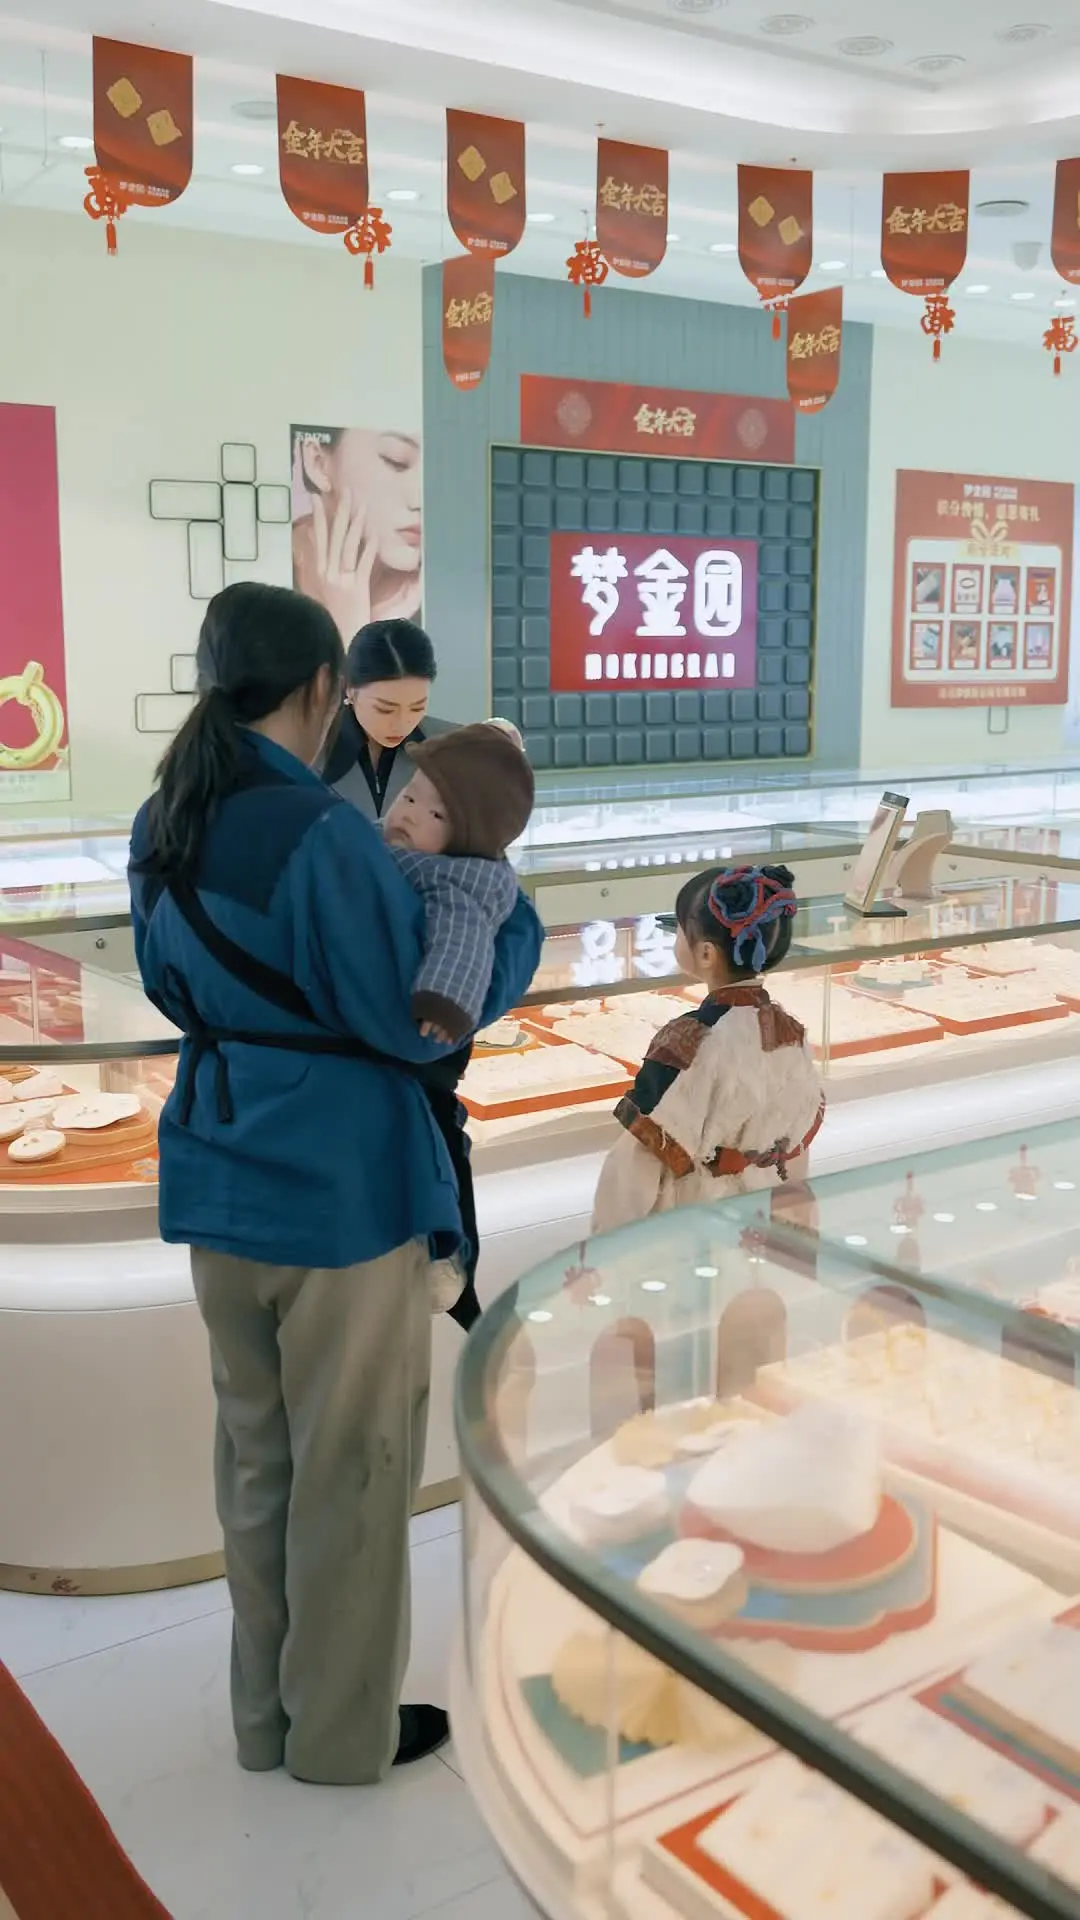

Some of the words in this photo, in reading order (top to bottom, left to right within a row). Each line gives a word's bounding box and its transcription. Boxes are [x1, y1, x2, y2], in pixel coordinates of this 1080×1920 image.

[282, 120, 364, 165] 金年大吉
[600, 176, 666, 217] 金年大吉
[885, 202, 967, 235] 金年大吉
[566, 240, 609, 285] 福
[445, 291, 494, 329] 金年大吉
[789, 324, 841, 360] 金年大吉
[1043, 316, 1078, 352] 福
[634, 403, 697, 437] 金年大吉
[570, 546, 743, 637] 梦金园
